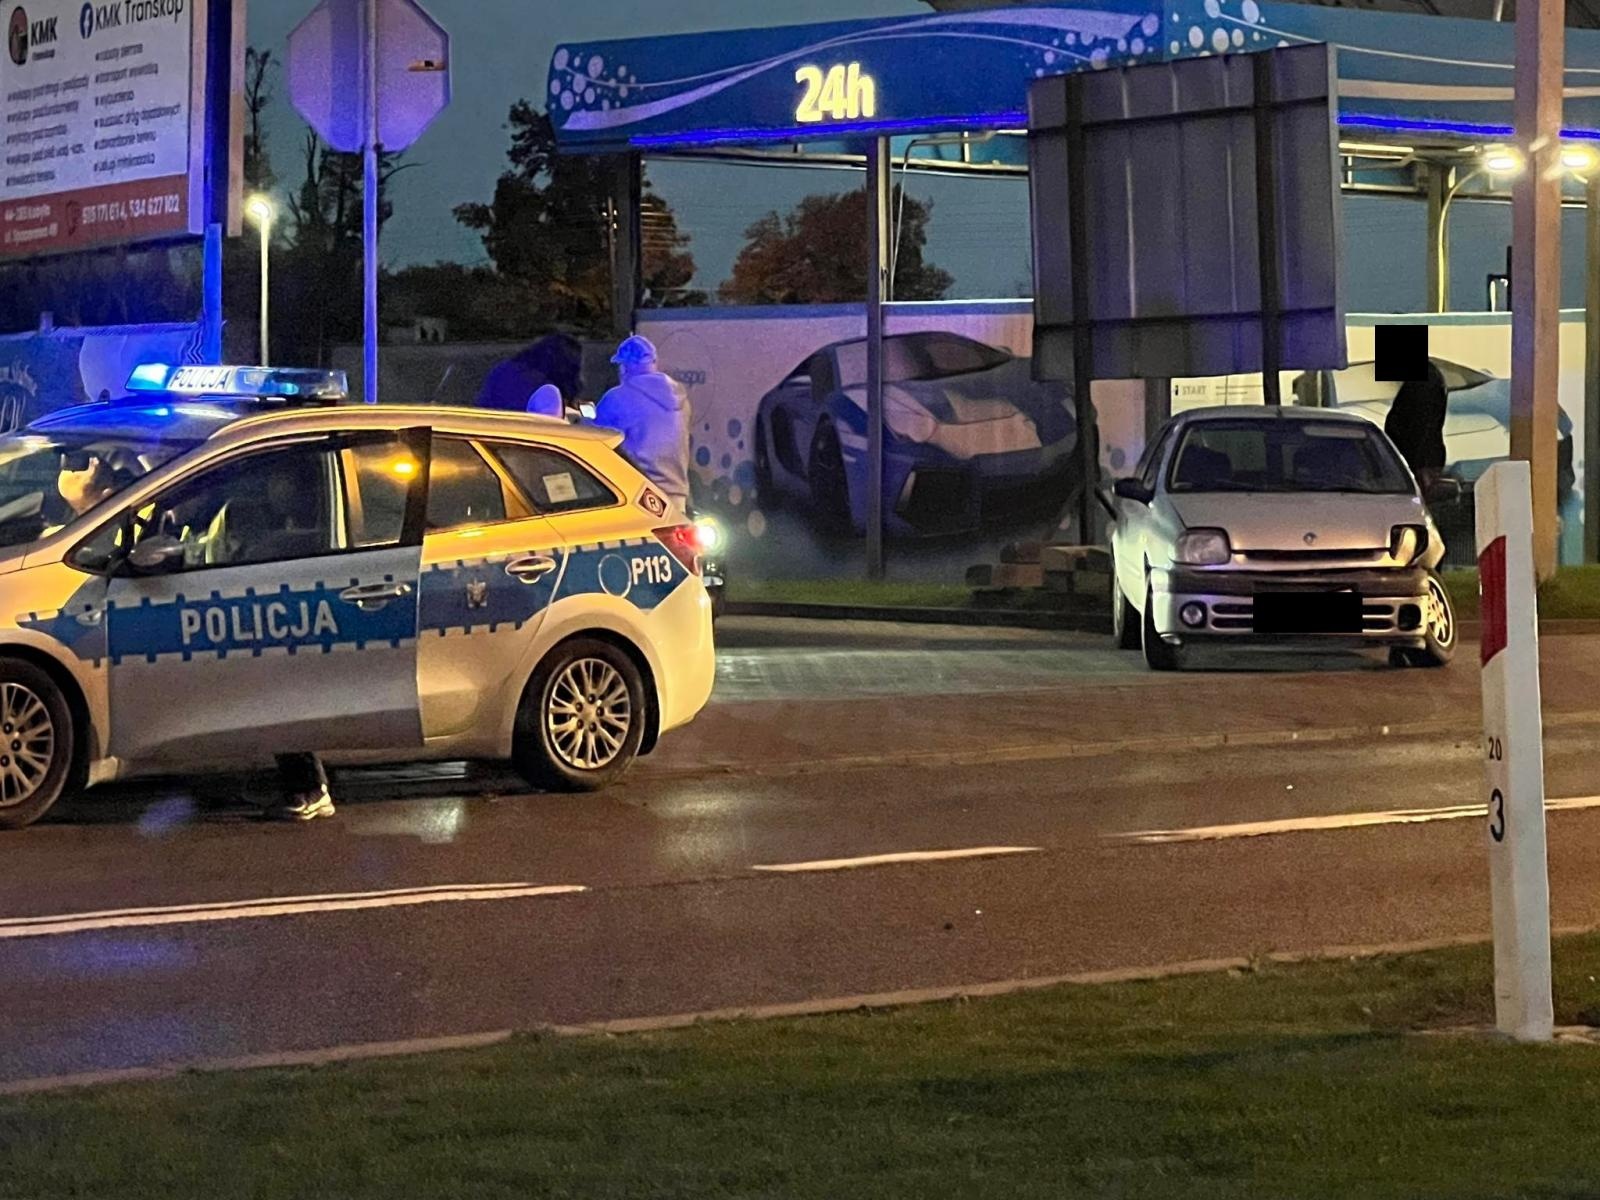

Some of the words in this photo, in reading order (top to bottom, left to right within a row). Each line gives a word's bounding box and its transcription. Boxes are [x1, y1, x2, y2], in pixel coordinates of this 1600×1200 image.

[95, 2, 121, 31] KMK
[125, 0, 184, 25] Transkop
[31, 16, 58, 47] KMK
[795, 61, 875, 122] 24h
[169, 368, 232, 389] POLICJA
[1182, 385, 1207, 396] START
[631, 555, 672, 585] P113
[180, 600, 338, 645] POLICJA
[1488, 736, 1502, 761] 20
[1490, 788, 1505, 842] 3
